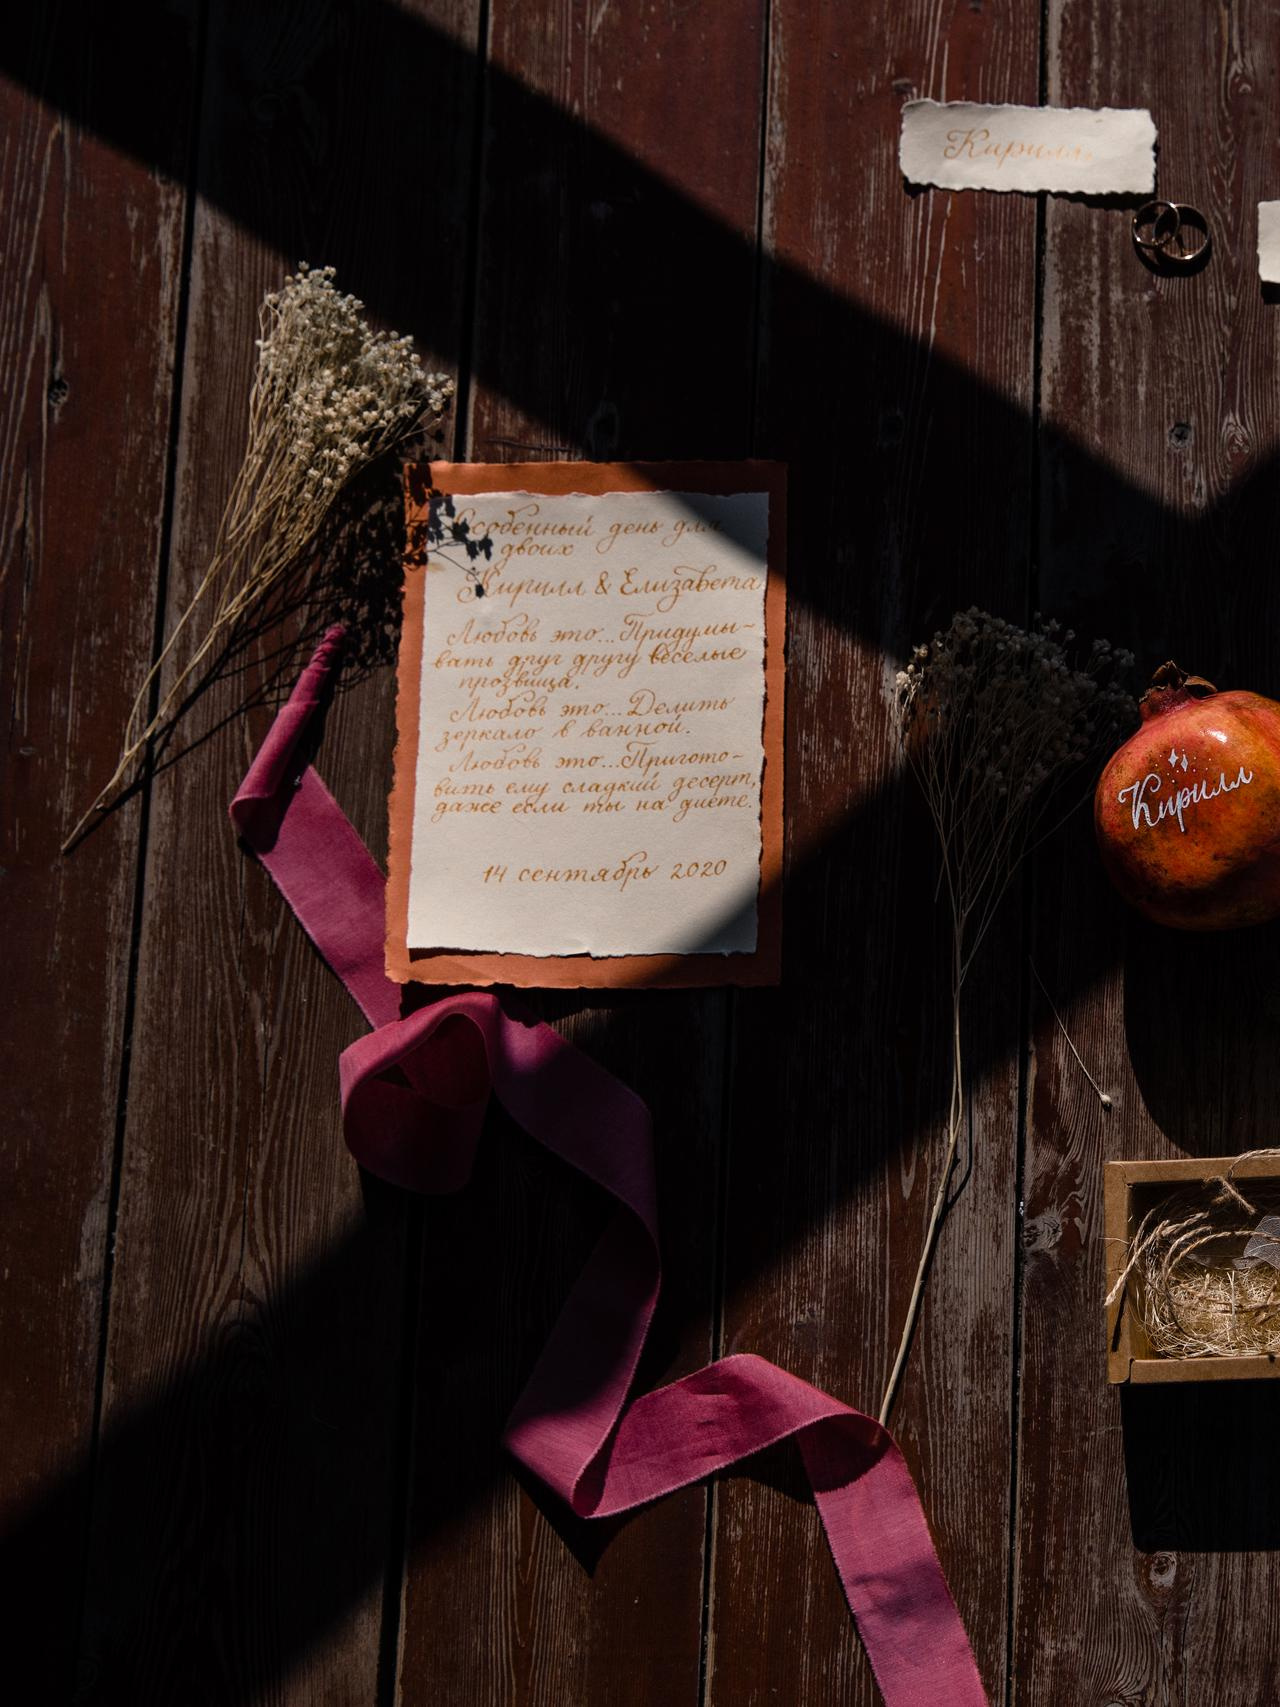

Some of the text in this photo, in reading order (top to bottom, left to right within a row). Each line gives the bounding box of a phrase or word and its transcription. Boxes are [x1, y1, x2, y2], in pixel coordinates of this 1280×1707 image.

[495, 537, 574, 568] двоих
[596, 521, 660, 554] день
[662, 518, 723, 547] для
[457, 565, 763, 613] Кирилл & Елизавета
[447, 612, 540, 646] Любовь
[433, 649, 494, 669] вать
[503, 653, 562, 678] друг
[566, 652, 641, 678] другу
[458, 670, 580, 698] прозвища.
[449, 689, 548, 723] Любовь
[627, 688, 735, 717] Делить
[434, 715, 691, 751] зеркало в ванной.
[449, 743, 541, 773] Любовь
[433, 772, 757, 802] вить ему сладкий десерт,
[1117, 766, 1253, 832] Кирилл
[431, 792, 753, 823] даже если ты на диете.
[483, 850, 728, 892] 14 сентябрь 2020
